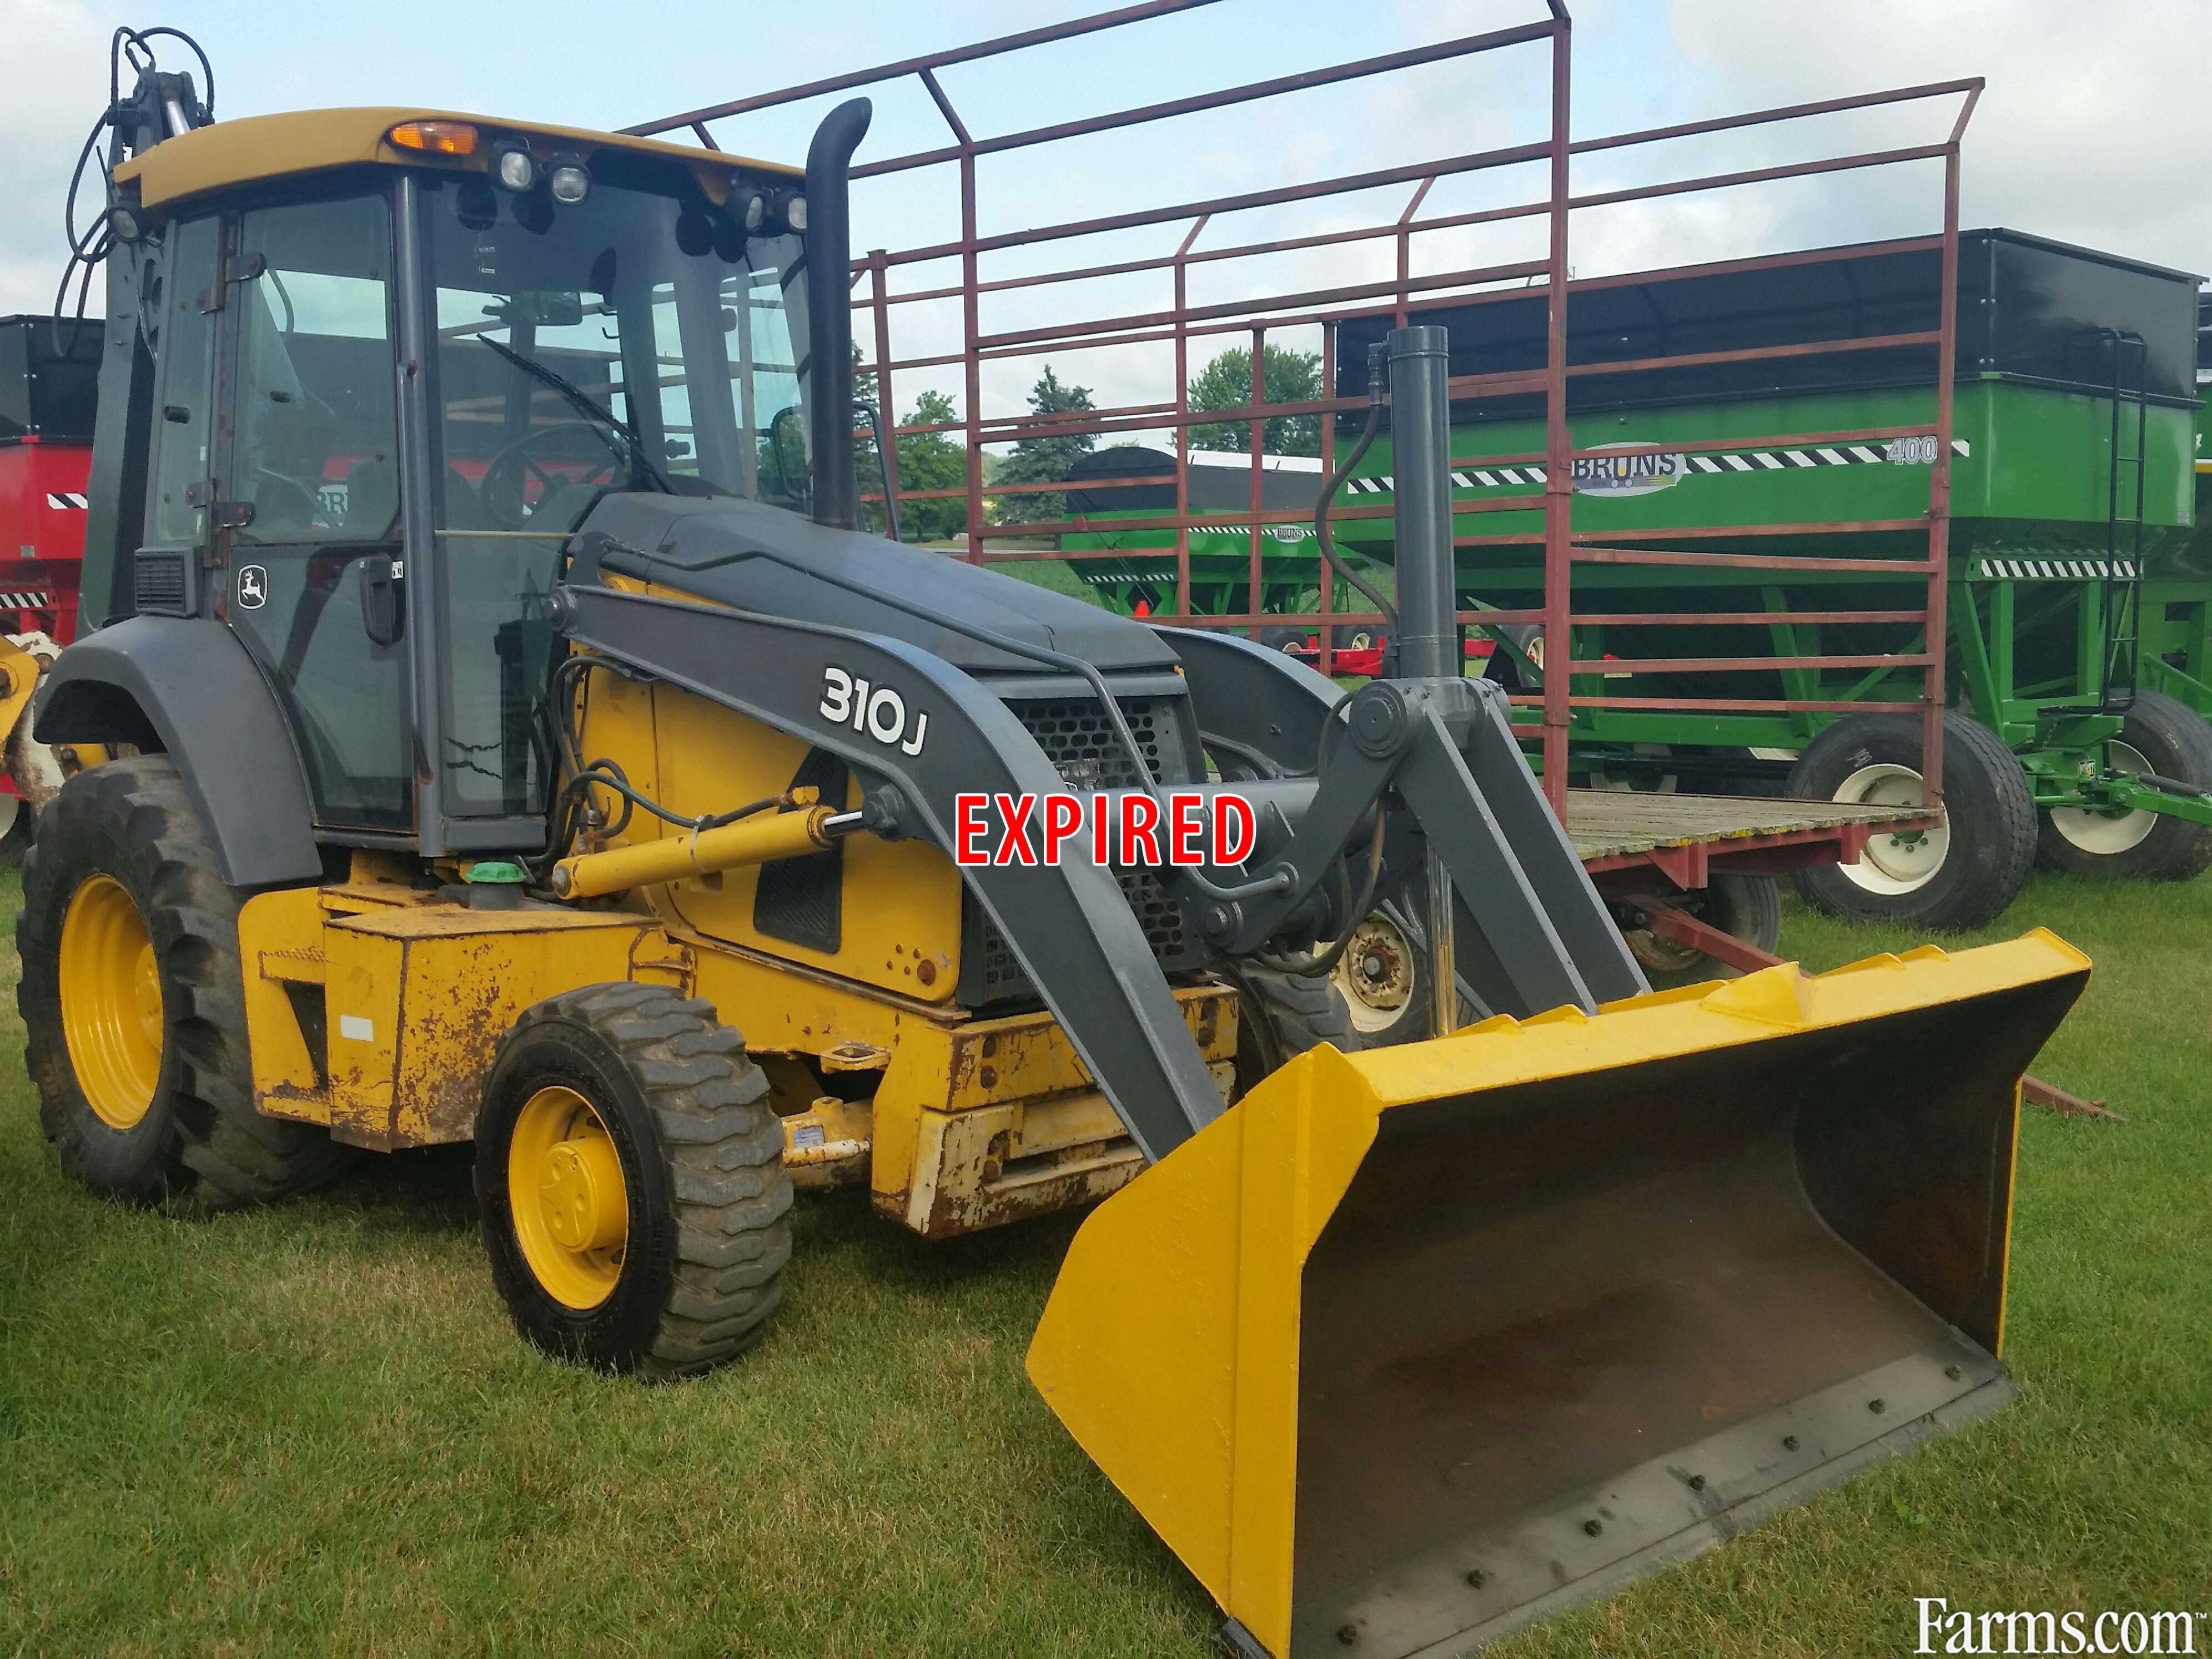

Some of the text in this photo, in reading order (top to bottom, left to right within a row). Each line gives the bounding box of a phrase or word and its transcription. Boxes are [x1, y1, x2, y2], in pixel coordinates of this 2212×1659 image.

[1887, 436, 1938, 465] 400
[1572, 453, 1676, 481] BRUNS
[1278, 527, 1303, 538] BRUNS
[820, 667, 927, 756] 310J
